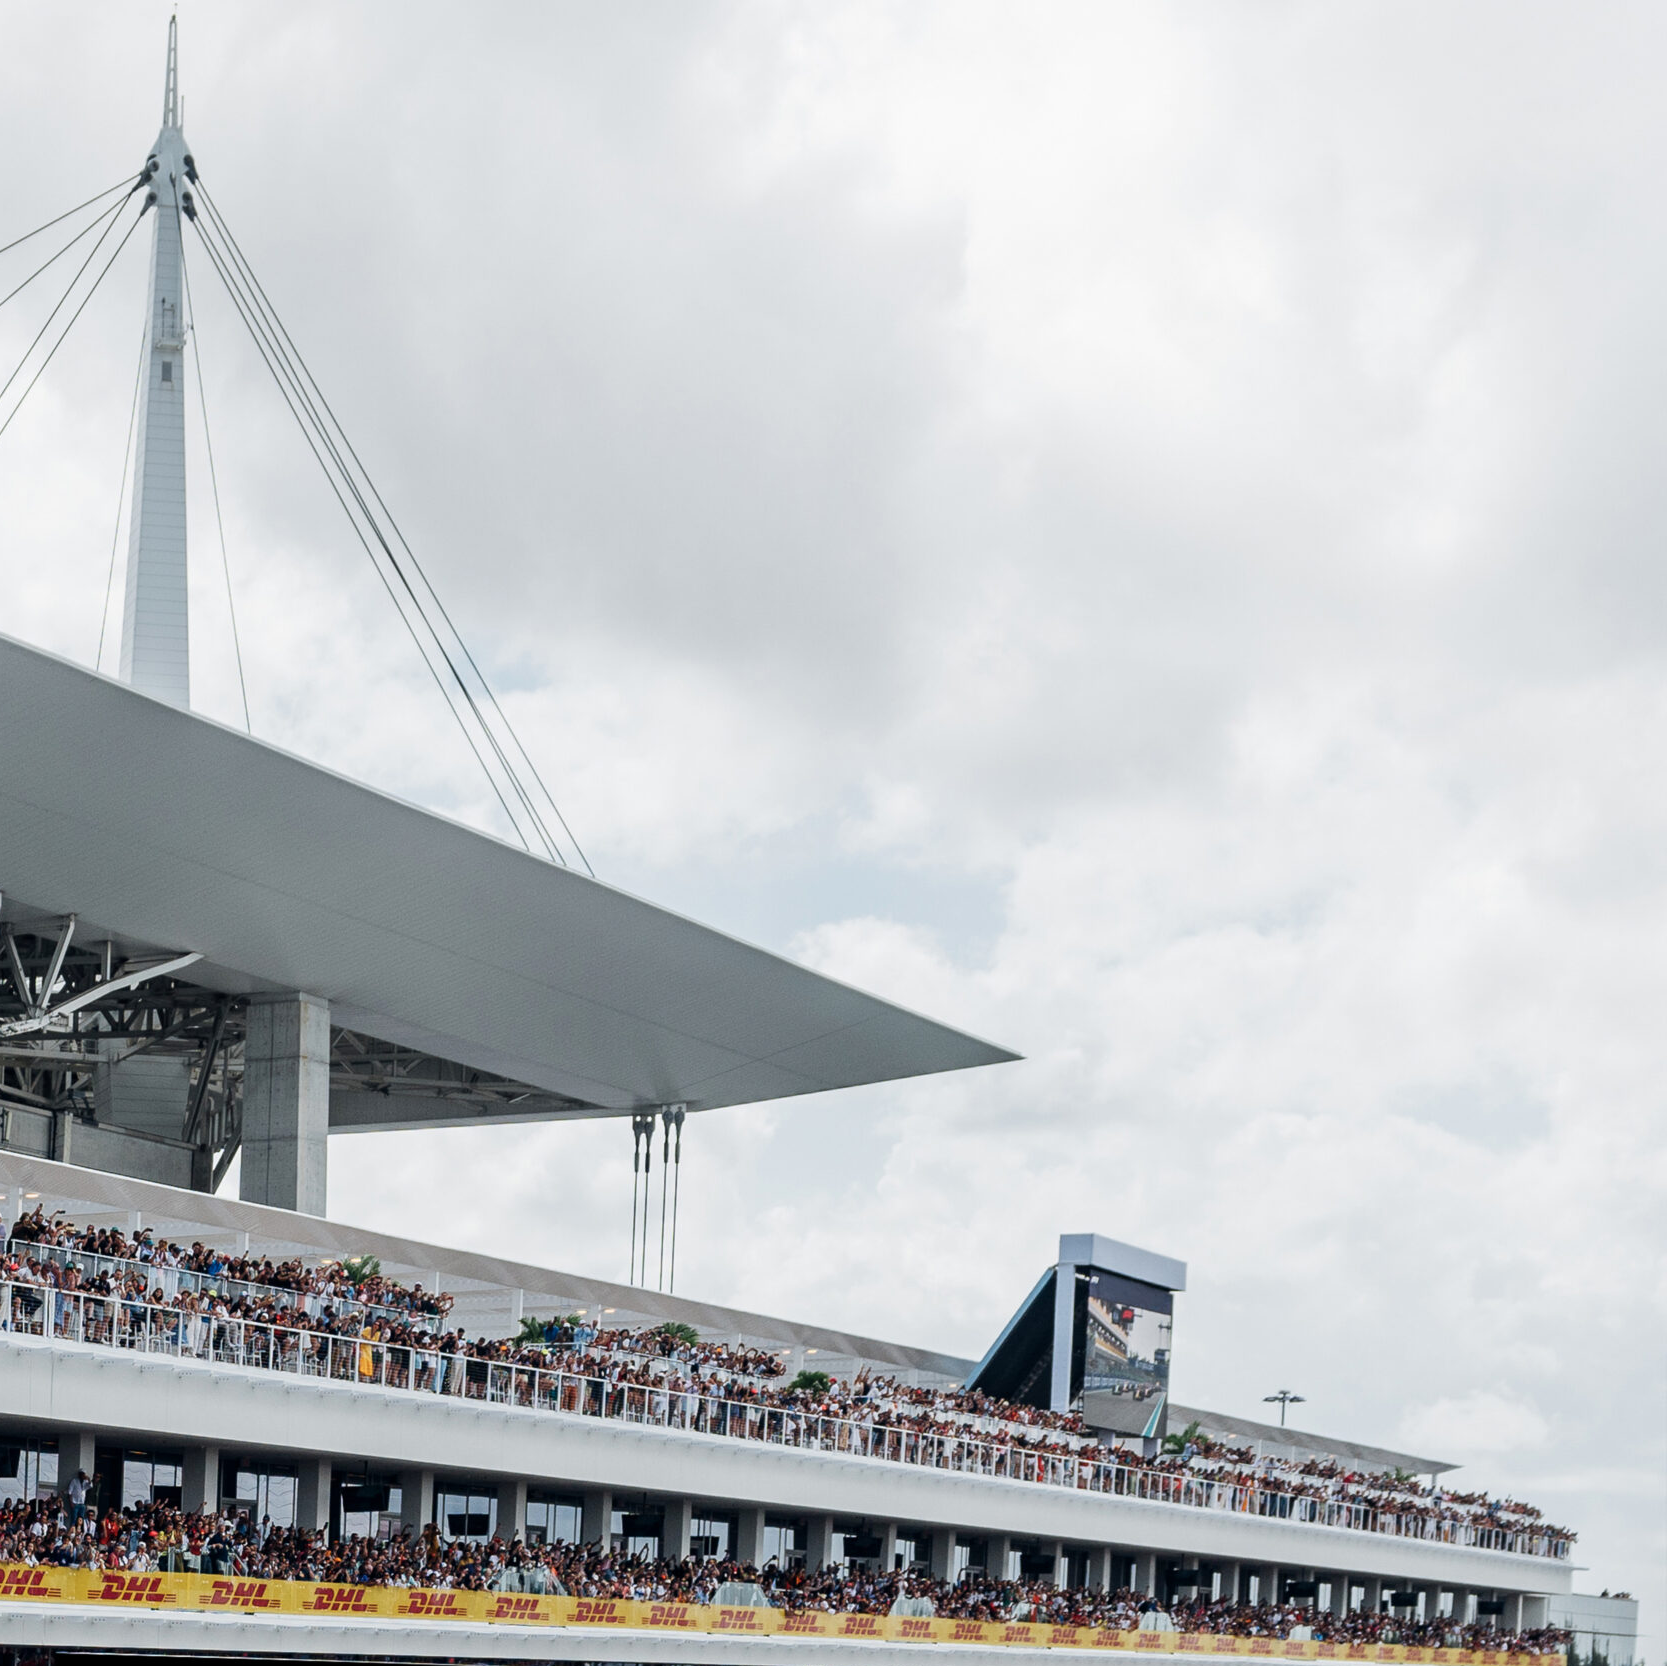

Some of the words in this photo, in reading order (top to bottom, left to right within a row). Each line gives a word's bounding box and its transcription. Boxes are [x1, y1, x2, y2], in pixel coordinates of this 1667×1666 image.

[100, 1574, 165, 1602] DHL
[210, 1581, 269, 1607] DHL
[312, 1587, 367, 1611] DHL
[407, 1592, 459, 1615] DHL
